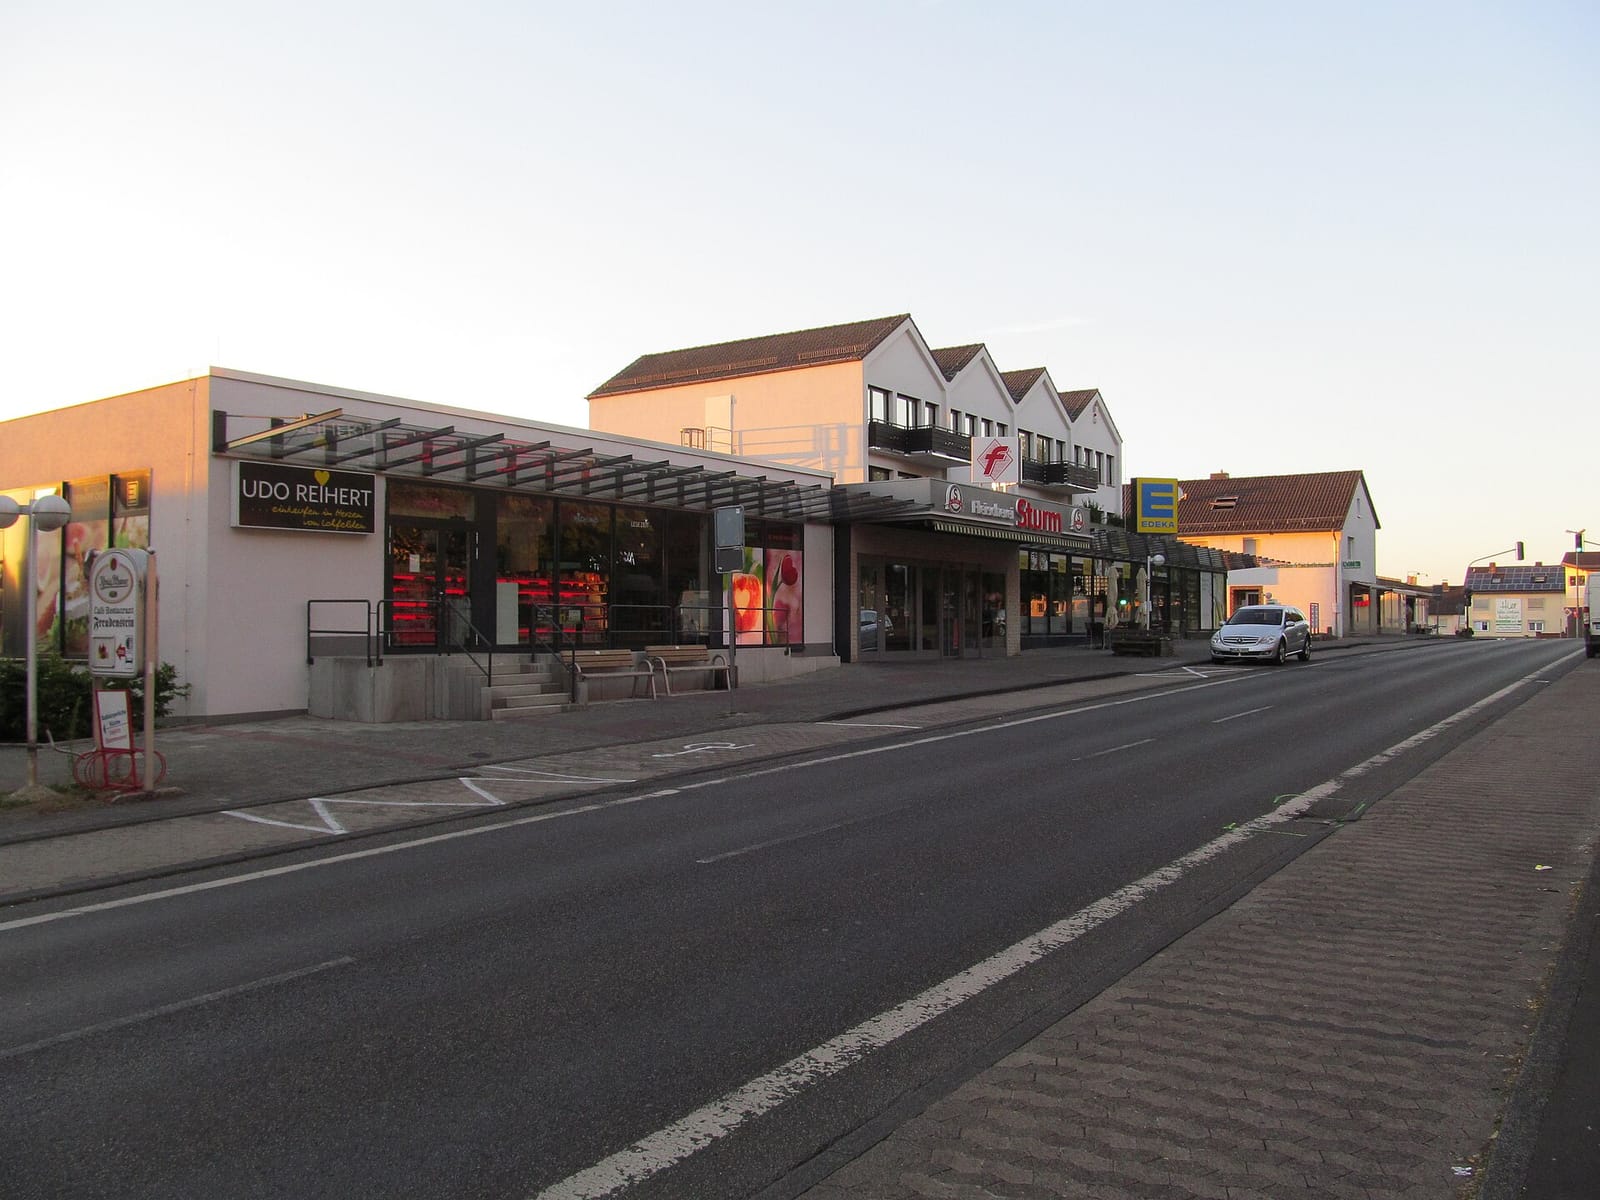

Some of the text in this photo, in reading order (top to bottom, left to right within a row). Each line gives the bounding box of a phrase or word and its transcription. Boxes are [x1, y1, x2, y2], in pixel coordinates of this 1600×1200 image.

[242, 479, 372, 507] UDO REIHERT
[272, 505, 320, 517] einkaufen
[335, 509, 364, 519] Herzen
[1015, 498, 1062, 533] Sturm
[321, 518, 368, 530] Lohfelden
[1141, 520, 1175, 528] EDEKA
[93, 616, 134, 630] Freudenstein
